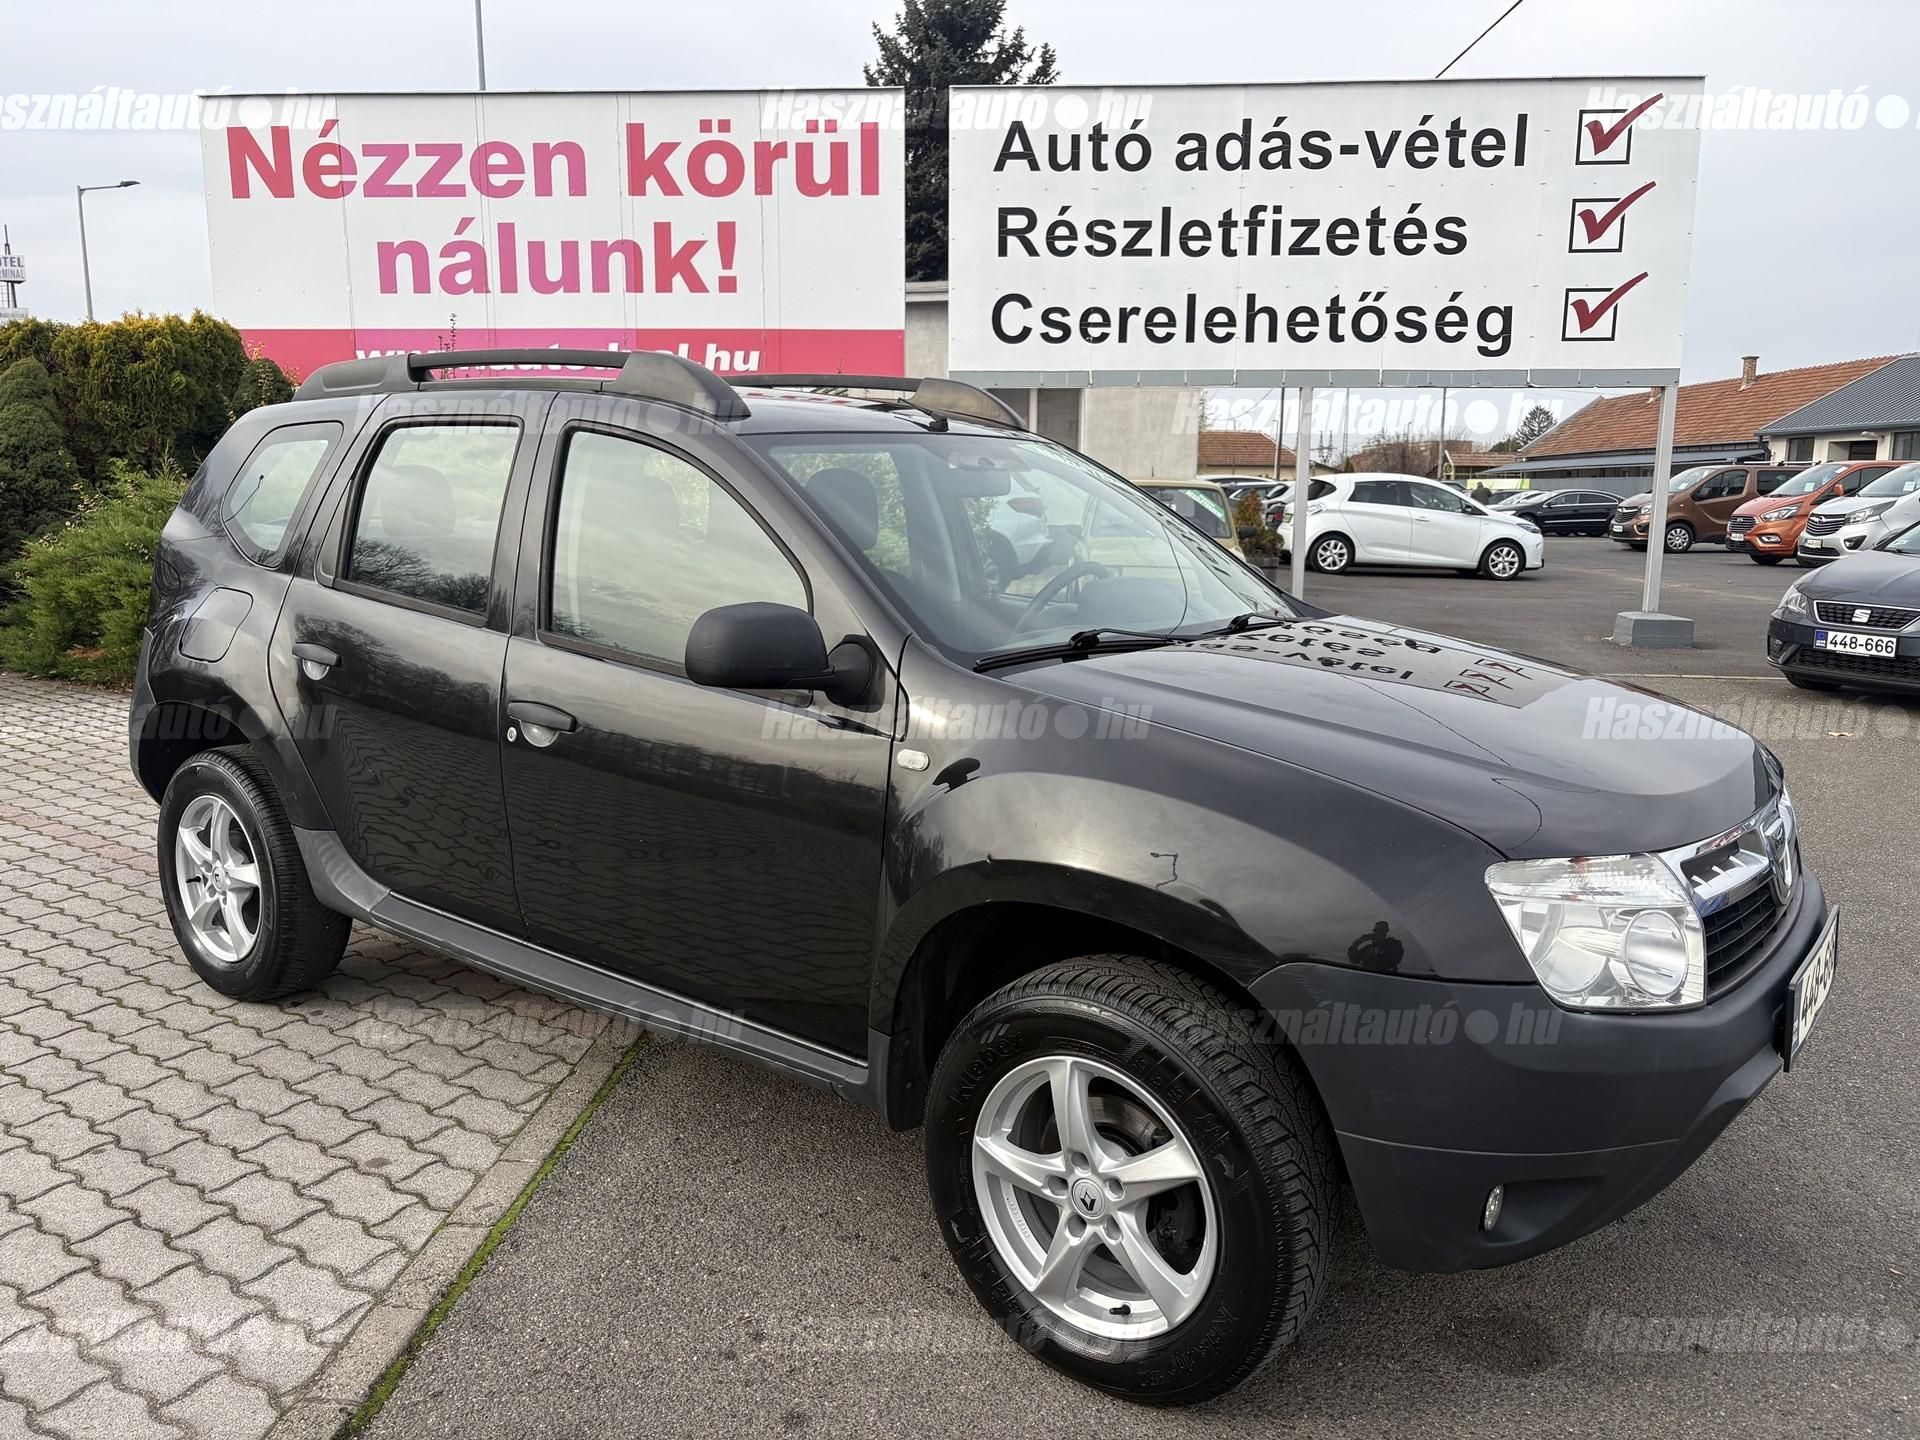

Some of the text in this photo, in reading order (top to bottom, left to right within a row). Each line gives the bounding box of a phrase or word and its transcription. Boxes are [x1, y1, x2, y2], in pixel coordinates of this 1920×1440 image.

[227, 119, 880, 200] Nézzen körül
[993, 113, 1529, 172] Autó adás-vétel
[376, 217, 738, 296] nálunk!
[996, 202, 1468, 258] Részletfizetés
[991, 291, 1514, 357] Cserelehetőség
[1829, 632, 1895, 655] 448-666
